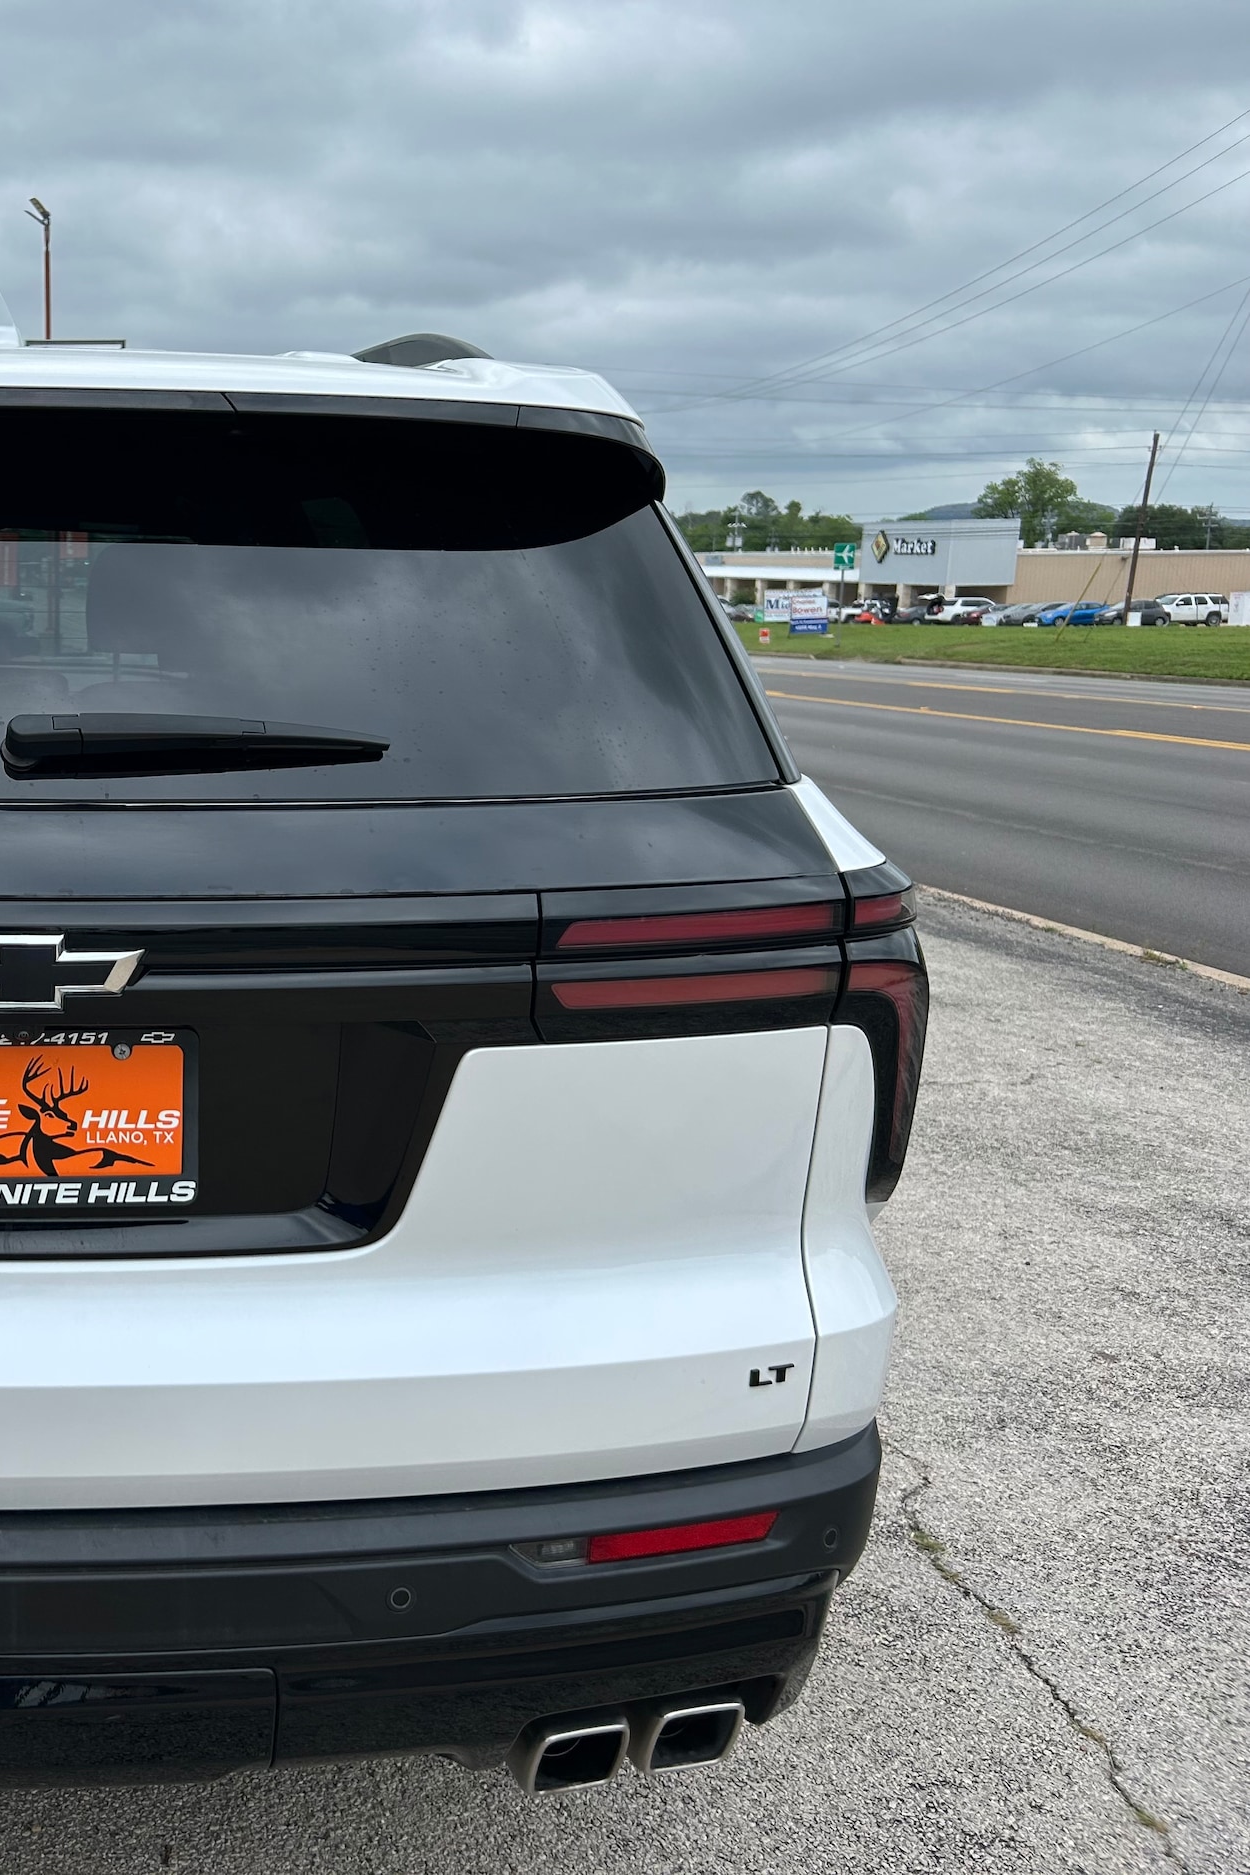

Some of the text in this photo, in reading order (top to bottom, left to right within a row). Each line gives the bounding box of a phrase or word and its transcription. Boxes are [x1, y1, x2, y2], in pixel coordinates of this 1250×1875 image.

[893, 538, 936, 555] Market
[81, 1109, 181, 1129] HILLS
[86, 1131, 175, 1145] LLANO, TX
[86, 1180, 196, 1204] HILLS
[749, 1363, 795, 1387] LT
